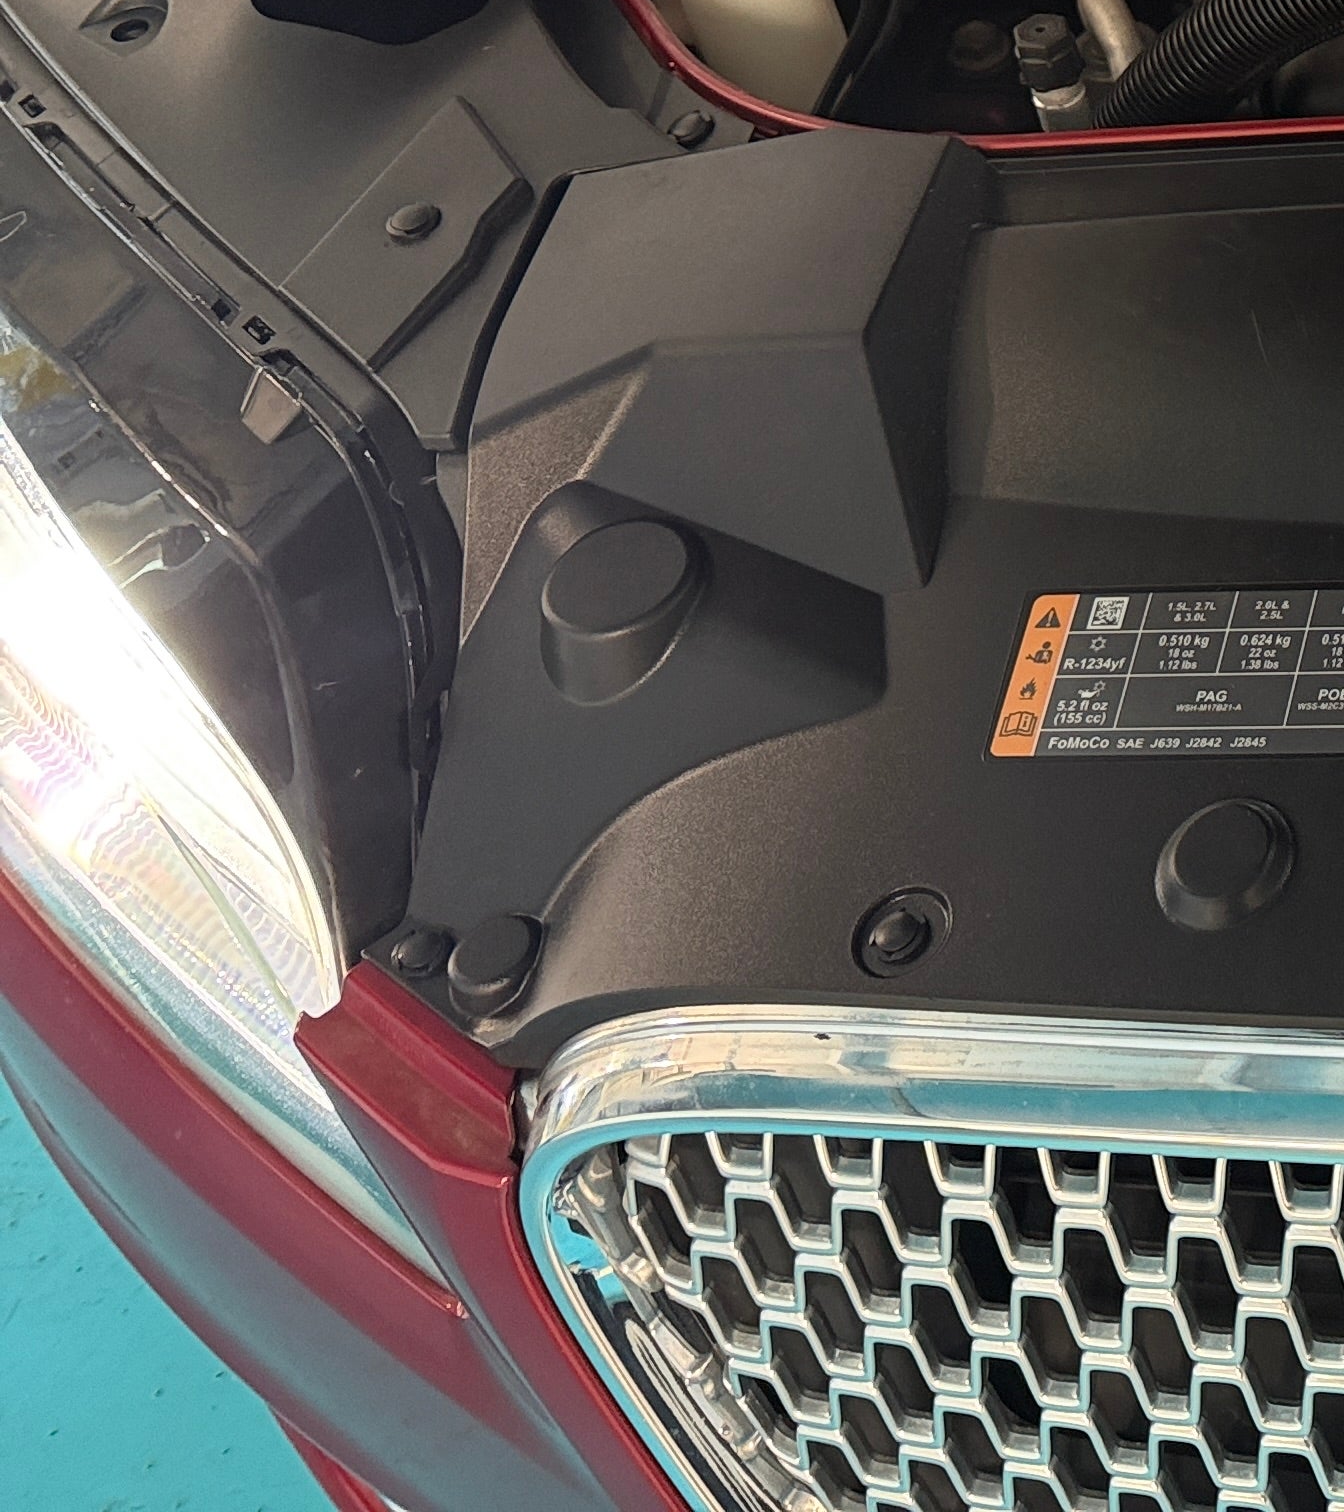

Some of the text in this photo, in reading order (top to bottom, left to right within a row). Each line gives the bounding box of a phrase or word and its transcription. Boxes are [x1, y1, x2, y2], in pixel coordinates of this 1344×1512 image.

[1281, 600, 1290, 610] &
[1174, 612, 1206, 622] & 3.0L
[1259, 610, 1284, 620] 2.5L
[1159, 634, 1210, 649] 0.510 kg
[1240, 634, 1291, 648] 0.624 kg
[1168, 649, 1180, 658] 18
[1249, 648, 1262, 657] 22
[1332, 648, 1343, 657] 18
[1063, 658, 1126, 672] R-1234yf
[1160, 660, 1197, 670] 1.12 lbs
[1241, 660, 1279, 669] 1.38 lbs
[1323, 658, 1342, 668] 1.12
[1195, 690, 1228, 702] PAG
[1057, 699, 1108, 711] 5.2 fl oz
[1054, 712, 1106, 726] (155 cc)
[1048, 737, 1266, 749] FoMoCo SAE J639 J2842 J2845
